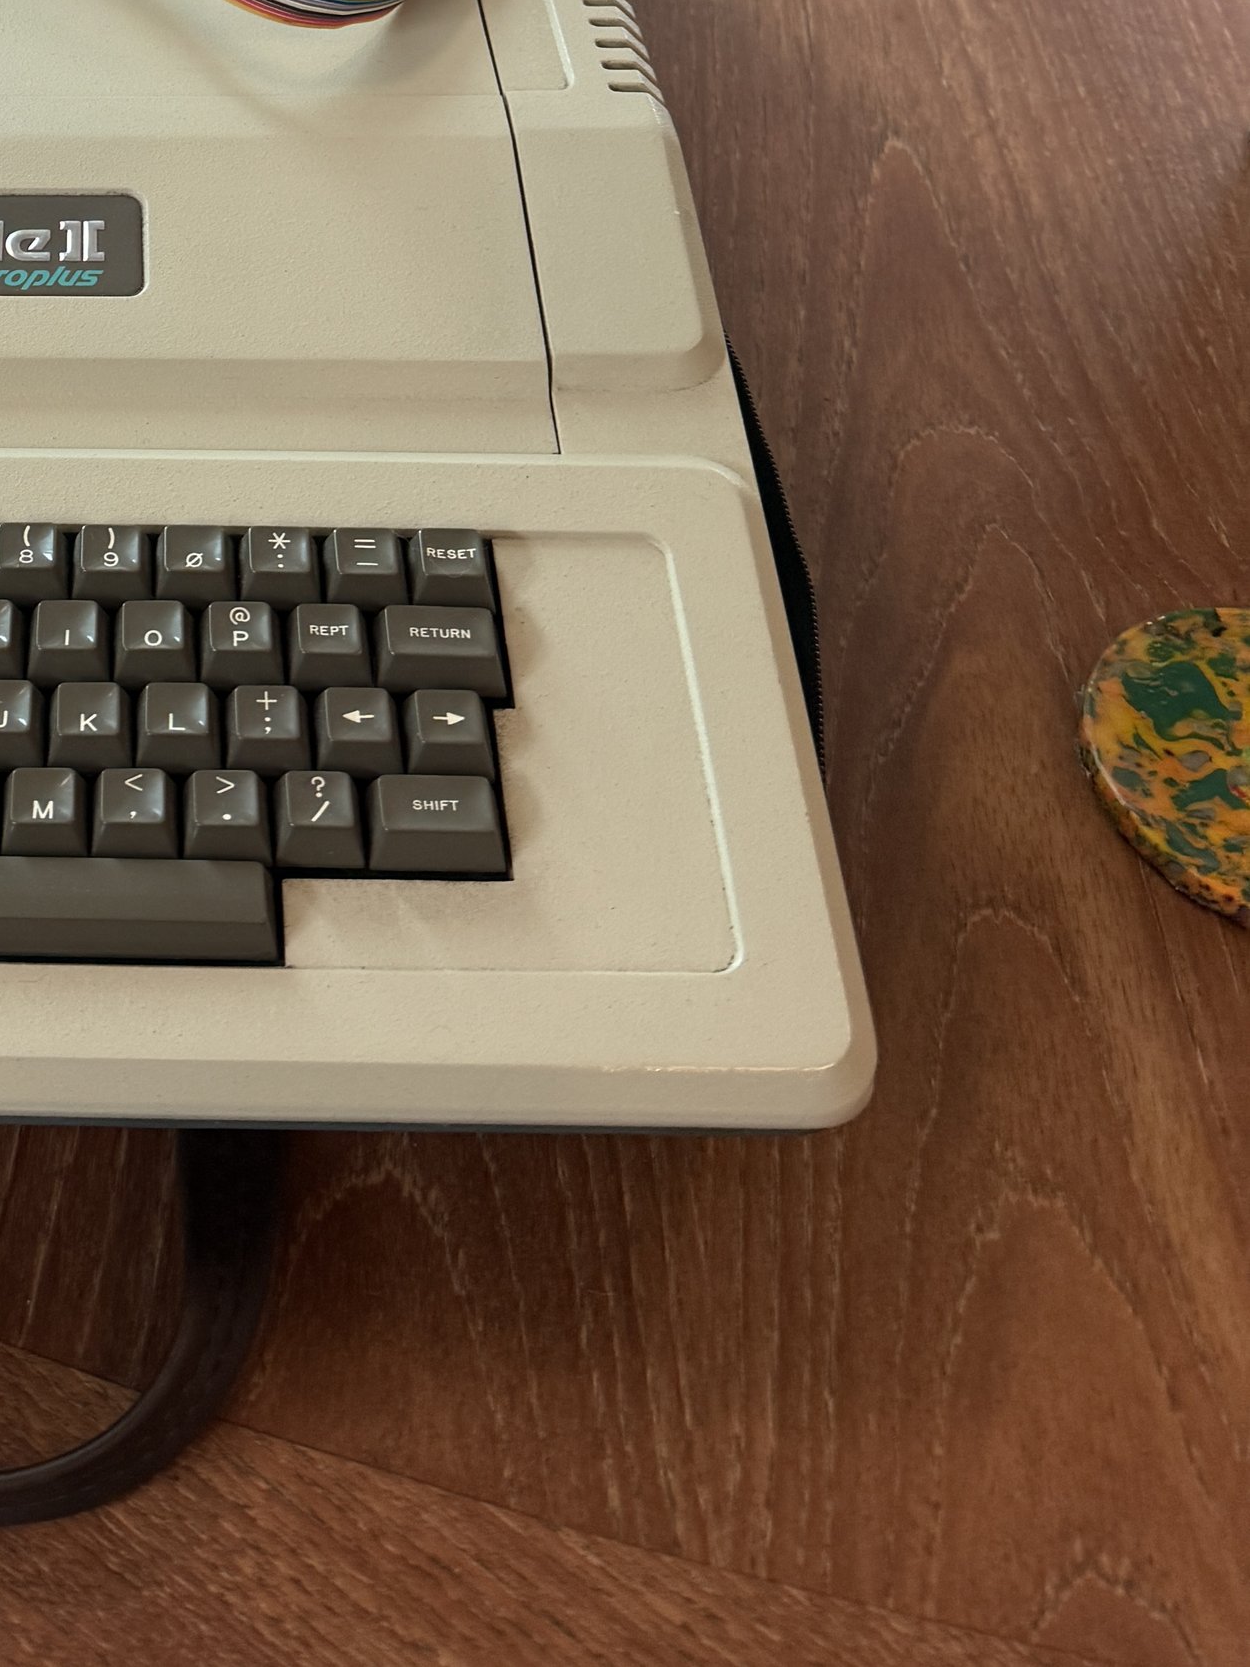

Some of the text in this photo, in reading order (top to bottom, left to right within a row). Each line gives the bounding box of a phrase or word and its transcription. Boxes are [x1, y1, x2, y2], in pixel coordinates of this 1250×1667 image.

[18, 548, 34, 564] 8
[103, 551, 119, 567] 9
[426, 546, 477, 560] RESET
[228, 606, 251, 626] @
[64, 629, 70, 646] I
[232, 630, 250, 647] P
[309, 624, 350, 637] REPT
[409, 626, 472, 640] RETURN
[255, 690, 278, 711] +
[79, 712, 98, 732] K
[168, 712, 186, 732] L
[311, 775, 326, 798] ?
[31, 799, 54, 820] M
[412, 799, 460, 812] SHIFT
